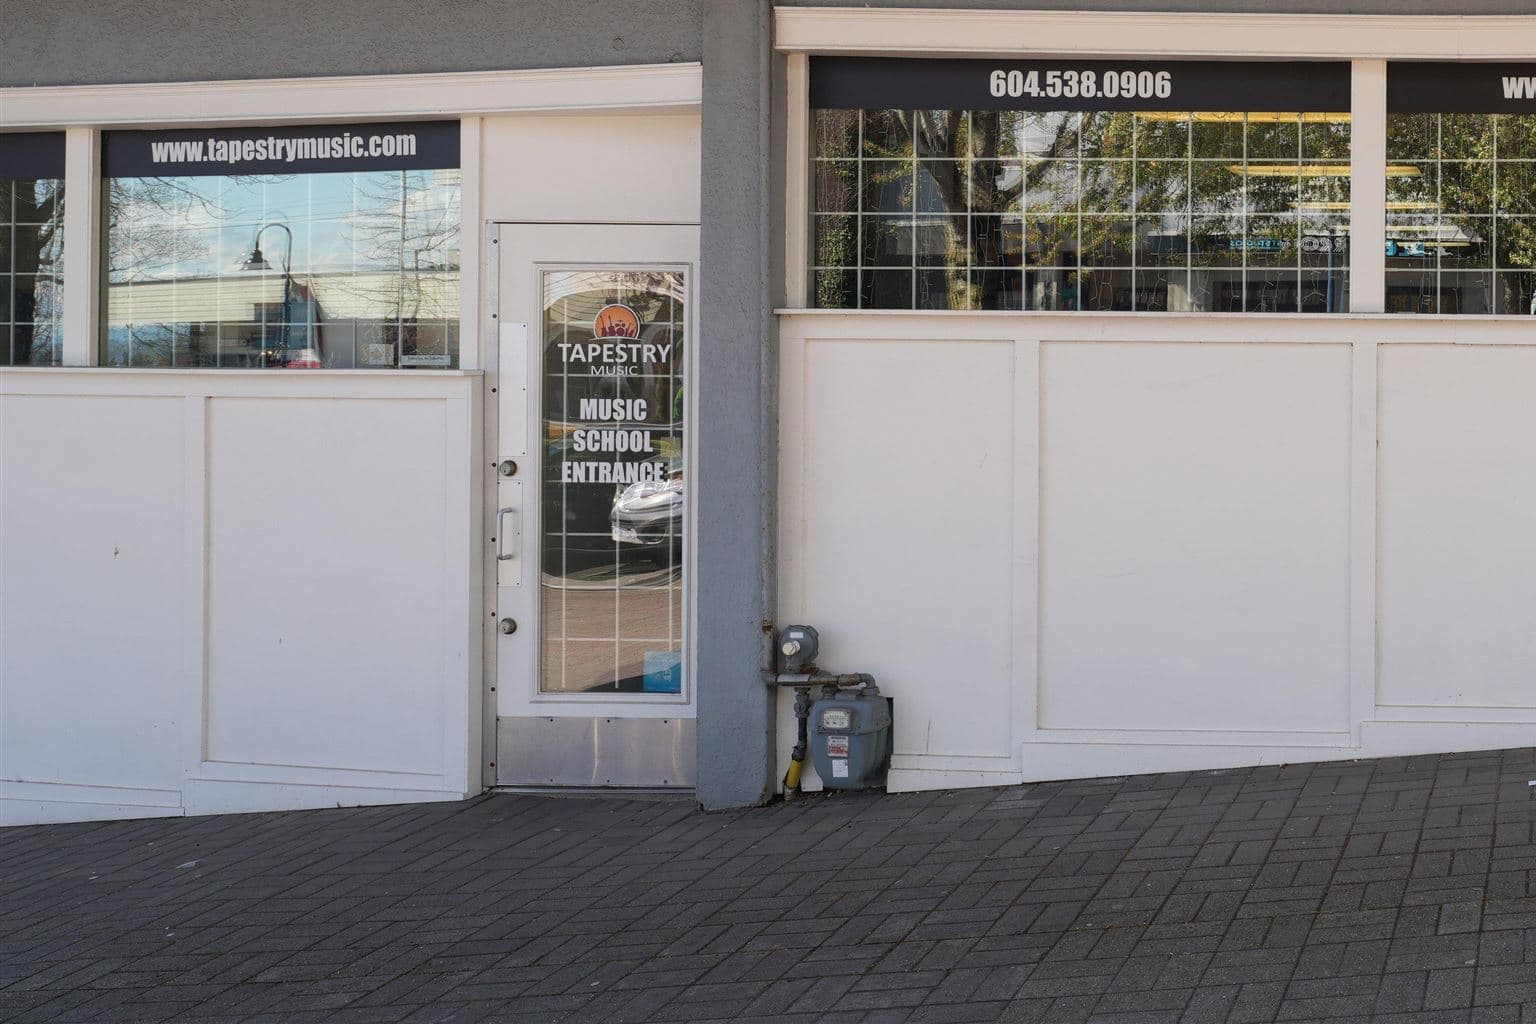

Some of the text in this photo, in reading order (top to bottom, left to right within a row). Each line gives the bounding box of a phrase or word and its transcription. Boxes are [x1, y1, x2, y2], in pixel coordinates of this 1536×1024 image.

[989, 69, 1172, 99] 604.538.0906
[151, 132, 417, 164] www.tapestrymusic.com
[557, 343, 672, 364] TAPESTRY
[590, 365, 639, 376] MUSIC
[579, 397, 648, 421] MUSIC
[572, 429, 654, 453] SCHOOL
[561, 461, 665, 484] ENTRANCE
